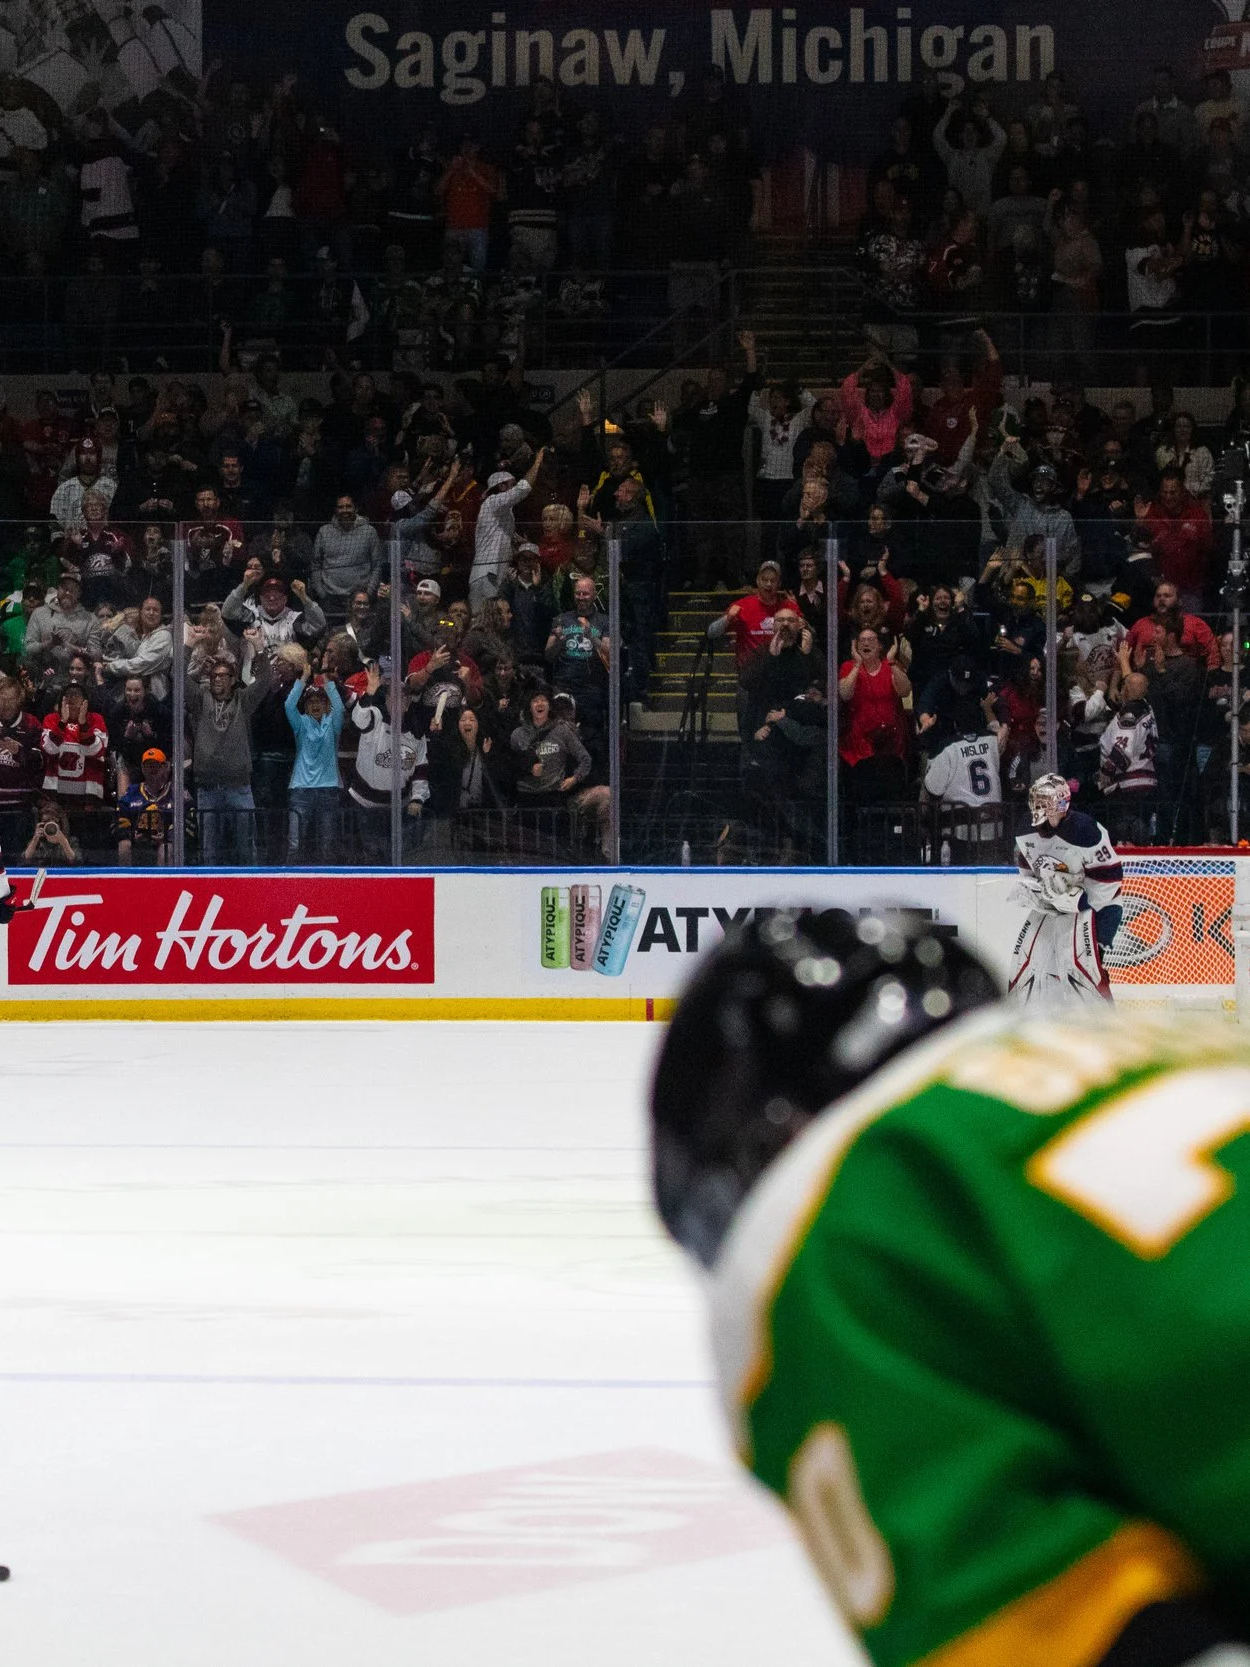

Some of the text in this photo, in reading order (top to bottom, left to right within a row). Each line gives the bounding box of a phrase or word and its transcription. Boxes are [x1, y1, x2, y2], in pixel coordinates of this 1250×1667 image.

[345, 8, 1056, 104] Saginaw, Michigan
[960, 743, 989, 758] HISLOP
[968, 758, 992, 796] 6
[1095, 845, 1112, 863] 29
[23, 889, 413, 972] Tim Hortons
[1013, 919, 1032, 956] VAUGHN
[1082, 920, 1092, 957] VAUGHN
